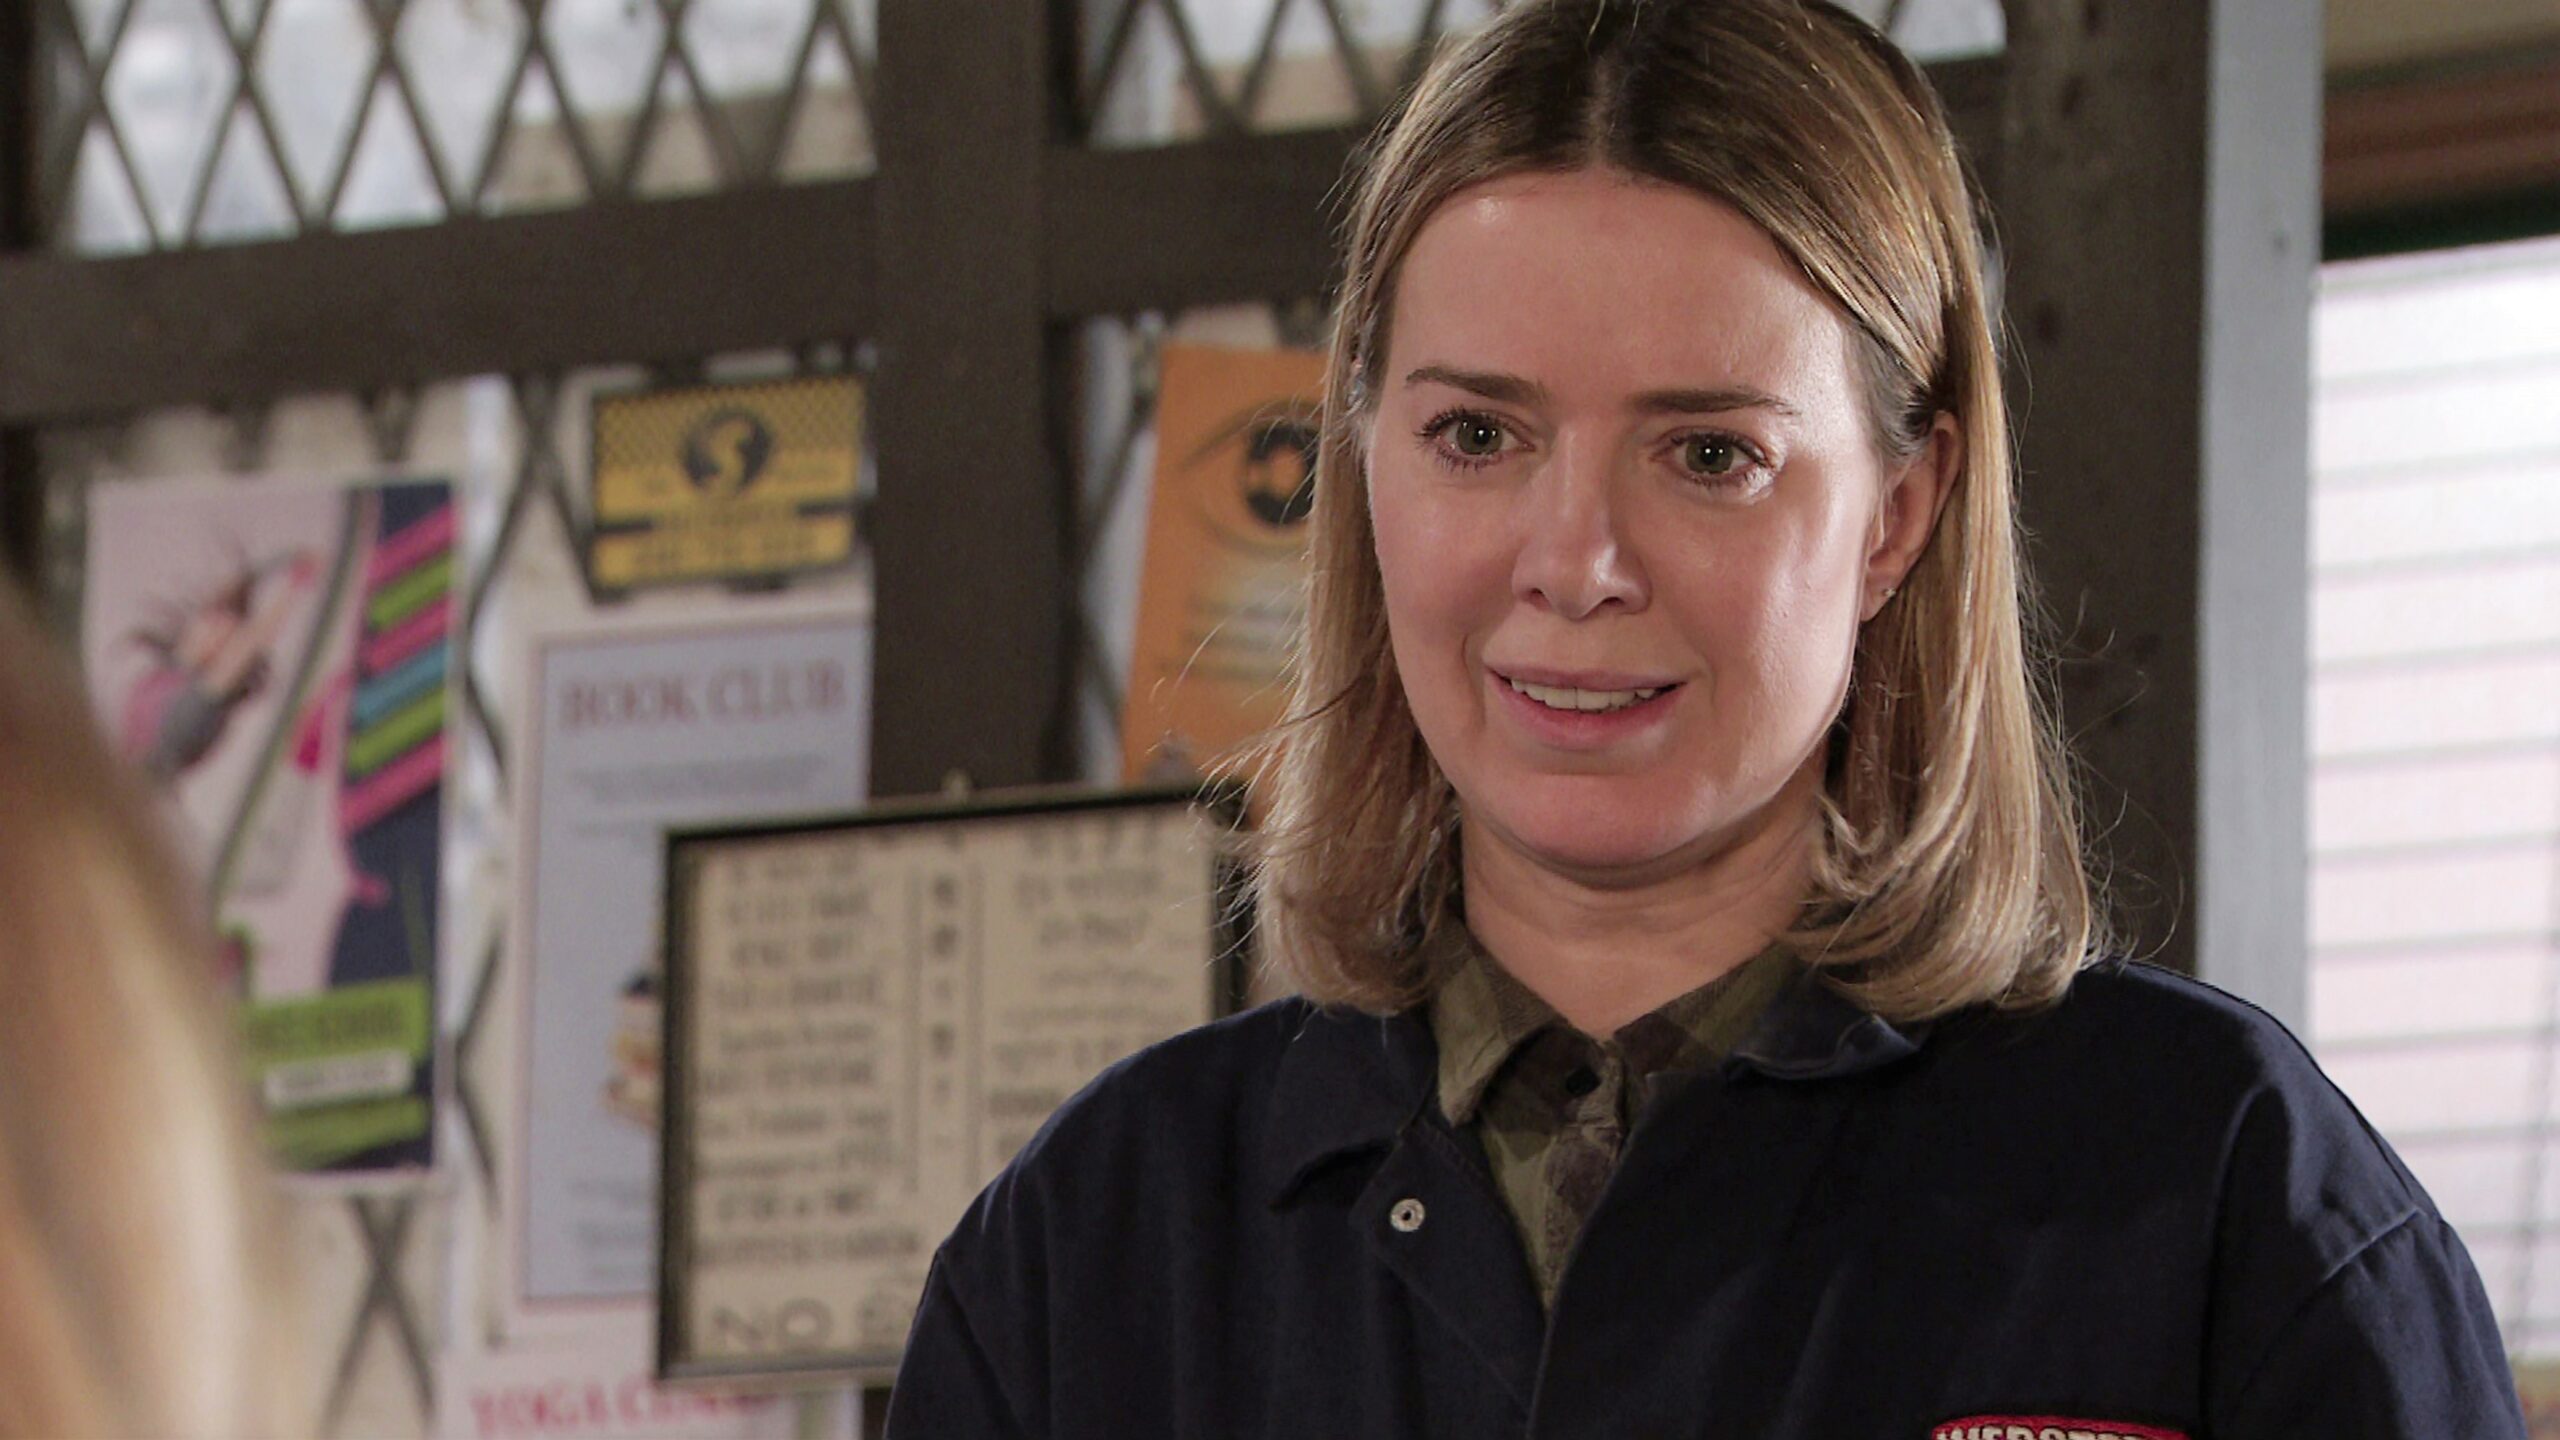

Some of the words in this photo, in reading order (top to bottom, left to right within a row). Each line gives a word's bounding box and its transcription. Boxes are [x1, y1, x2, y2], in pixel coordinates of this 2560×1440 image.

[559, 675, 695, 736] BOOK
[706, 658, 845, 720] CLUB
[468, 1382, 607, 1433] YOGA
